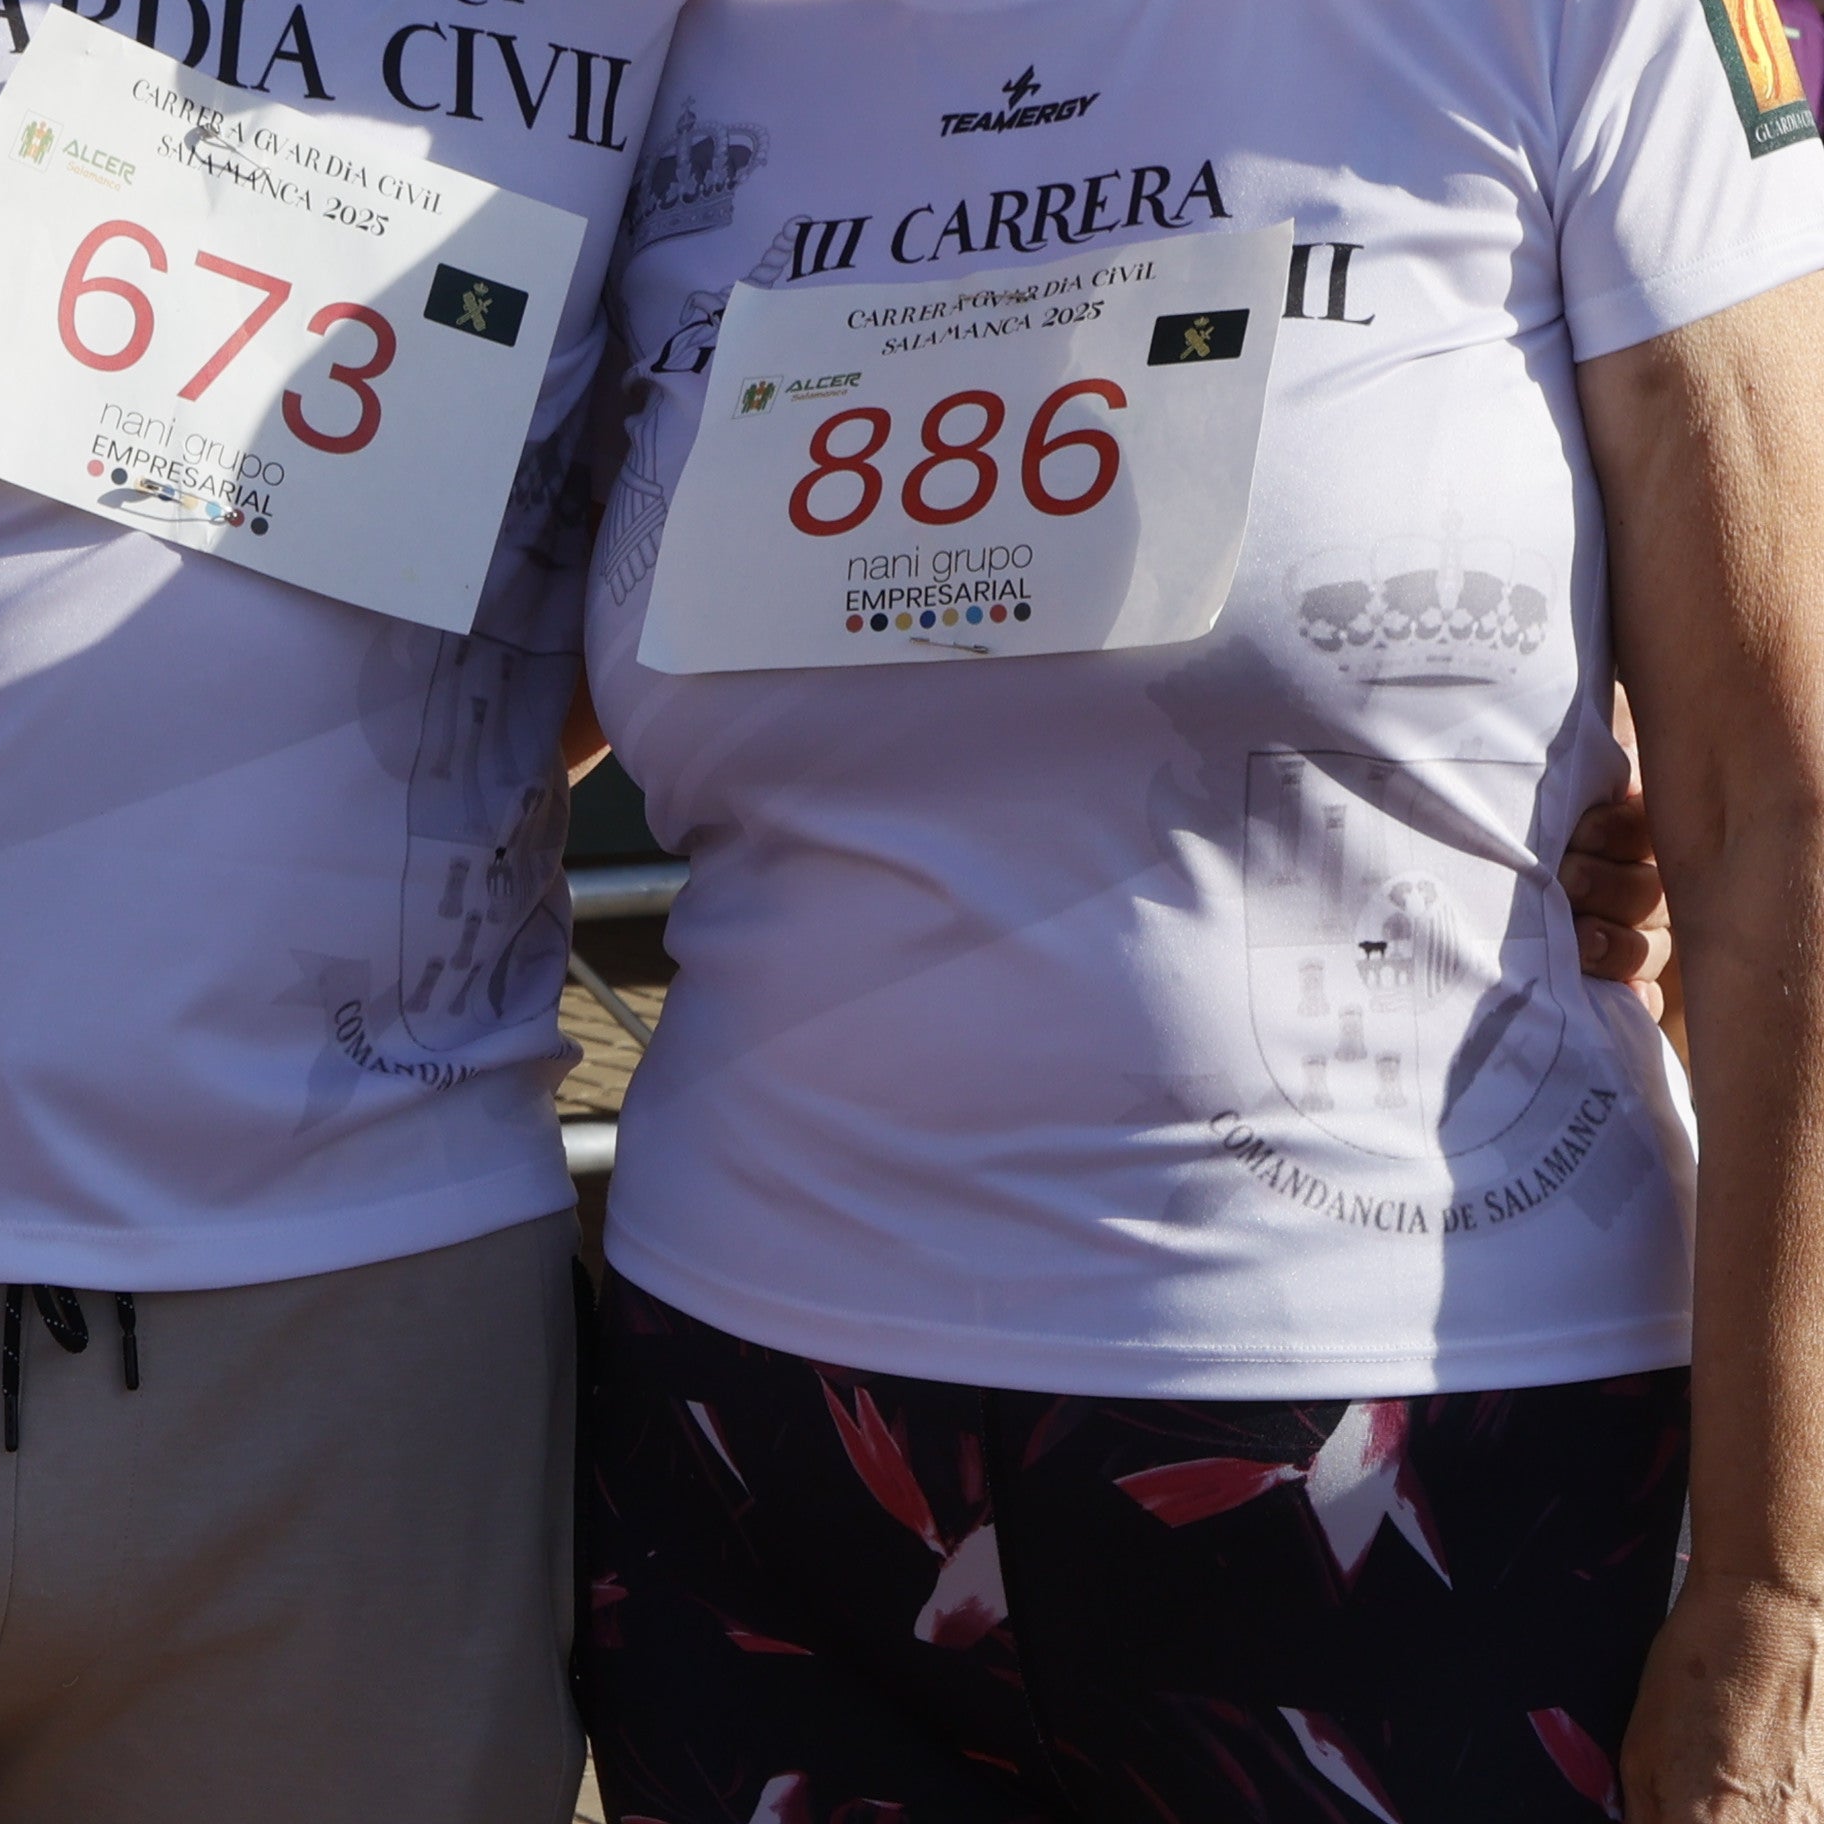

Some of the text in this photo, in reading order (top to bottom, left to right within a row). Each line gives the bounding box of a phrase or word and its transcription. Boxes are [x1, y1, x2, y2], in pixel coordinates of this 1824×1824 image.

[132, 78, 245, 144] CARRERA
[381, 20, 633, 154] CIVIL
[940, 92, 1102, 138] TEAMERGY
[62, 139, 136, 186] ALCER
[156, 134, 390, 237] SALAMANCA 2025
[788, 159, 1233, 282] III CARRERA
[57, 219, 397, 455] 673
[881, 299, 1105, 356] SALAMANCA 2025
[785, 372, 862, 393] ALCER
[91, 434, 275, 518] EMPRESARIAL
[100, 401, 285, 486] nani grupo
[788, 378, 1128, 537] 886
[845, 577, 1032, 612] EMPRESARIAL
[847, 543, 1034, 584] nani grupo
[1209, 1085, 1619, 1235] COMANDANCIA DE SALAMANCA
